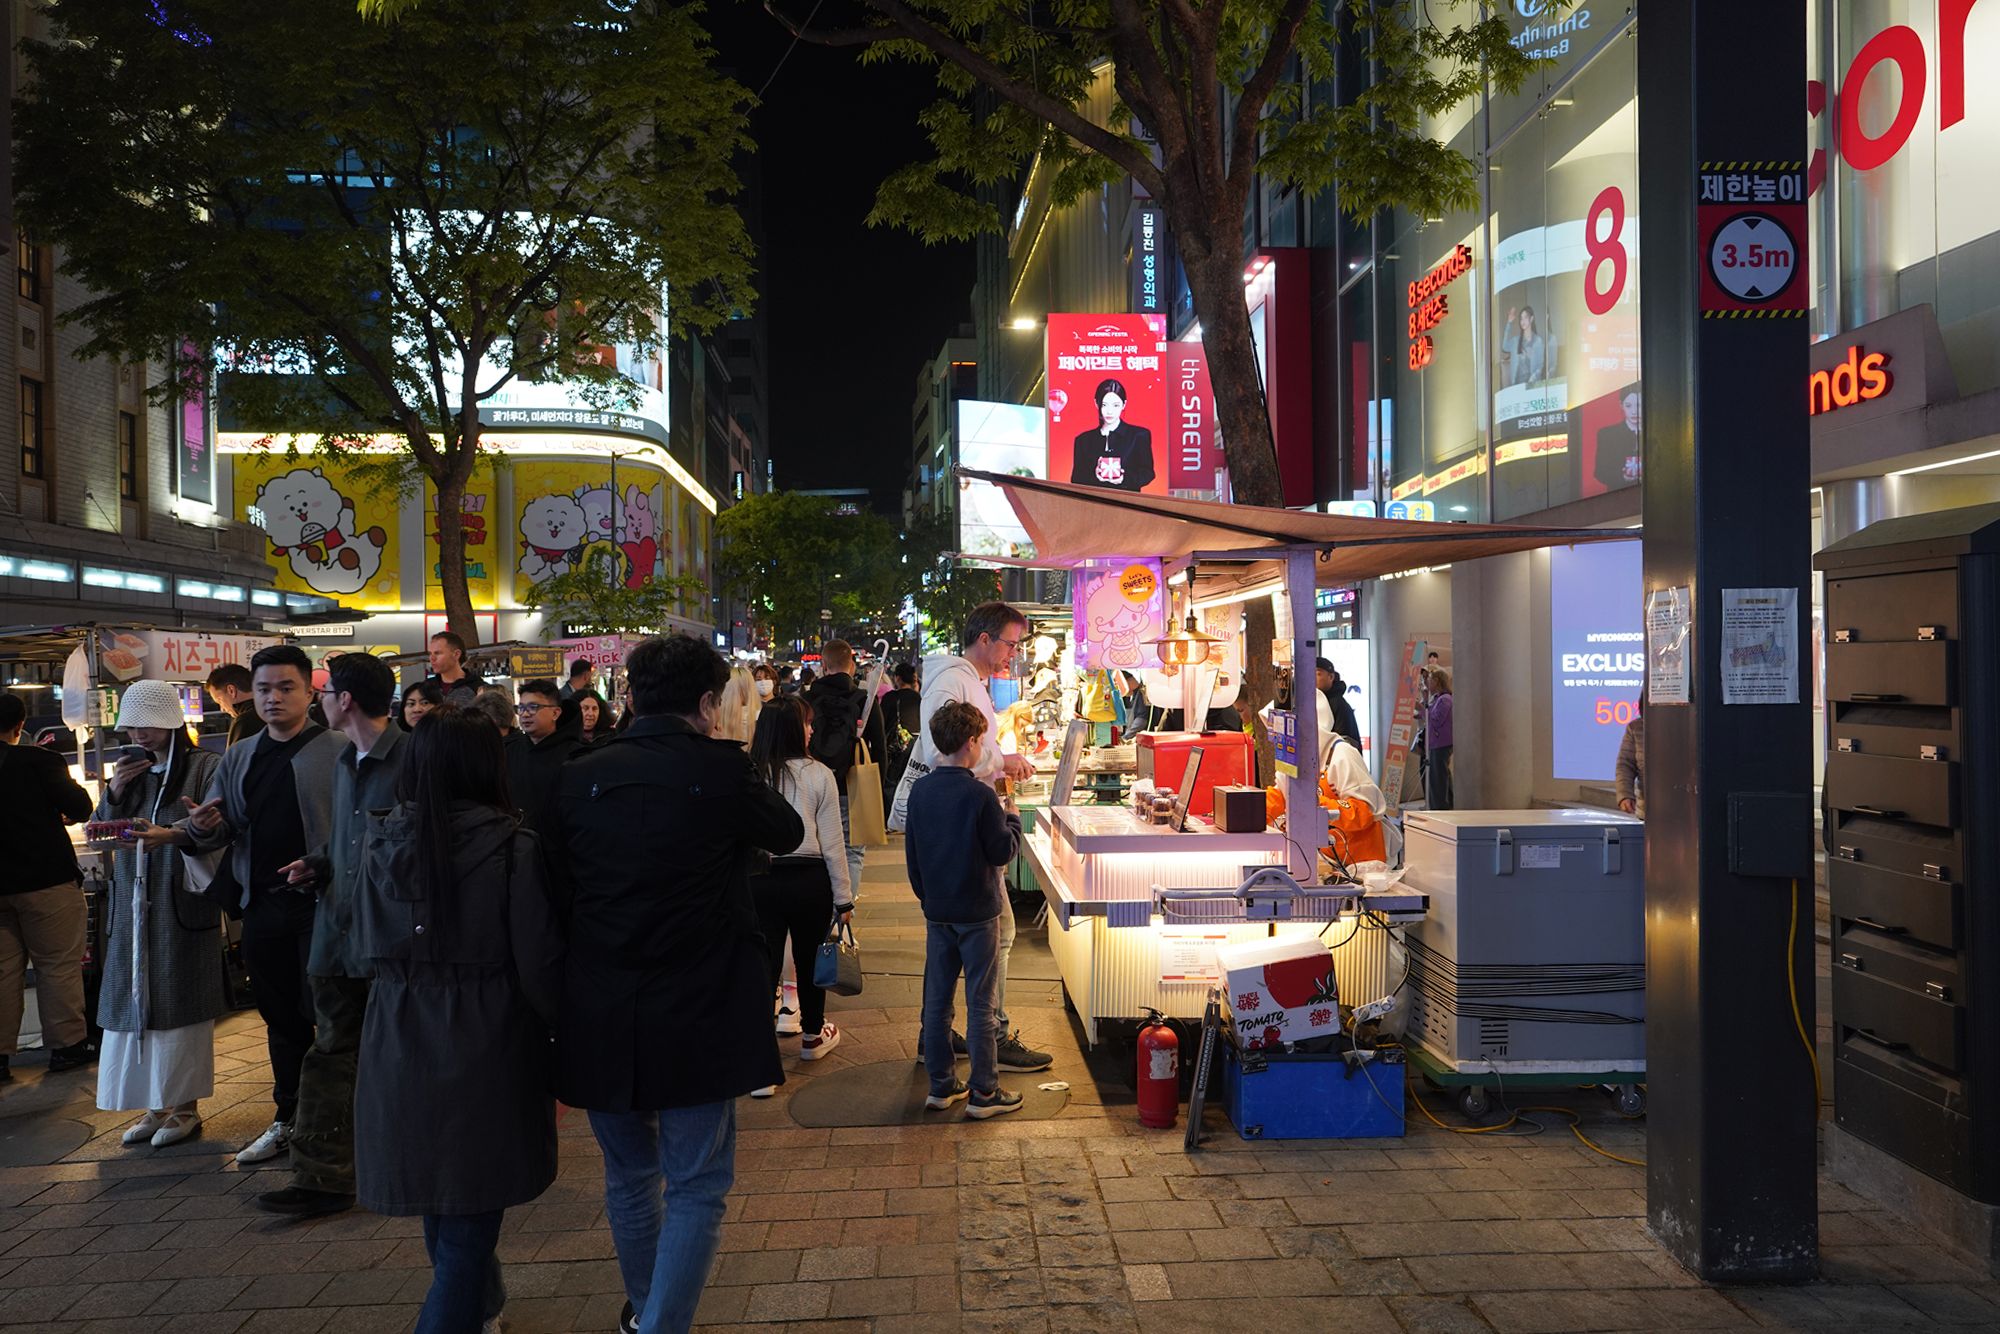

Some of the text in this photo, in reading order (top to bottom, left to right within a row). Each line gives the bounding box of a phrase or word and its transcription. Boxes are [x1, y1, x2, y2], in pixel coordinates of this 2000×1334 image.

[1700, 174, 1802, 202] 제한높이
[1143, 213, 1157, 308] 김동진 성형외과
[1584, 186, 1628, 316] 8
[1721, 244, 1790, 268] 3.5m
[1101, 345, 1123, 354] 소비의
[1123, 345, 1138, 354] 시작
[1058, 356, 1159, 371] 페이먼트 혜택
[1181, 359, 1200, 391] the
[493, 411, 529, 423] 꽃가루다,
[531, 411, 574, 423] 미세먼지다
[574, 412, 599, 424] 창문도
[1122, 576, 1152, 590] SWEETS
[163, 637, 239, 674] 치즈구이
[1238, 1011, 1285, 1033] TOMATO
